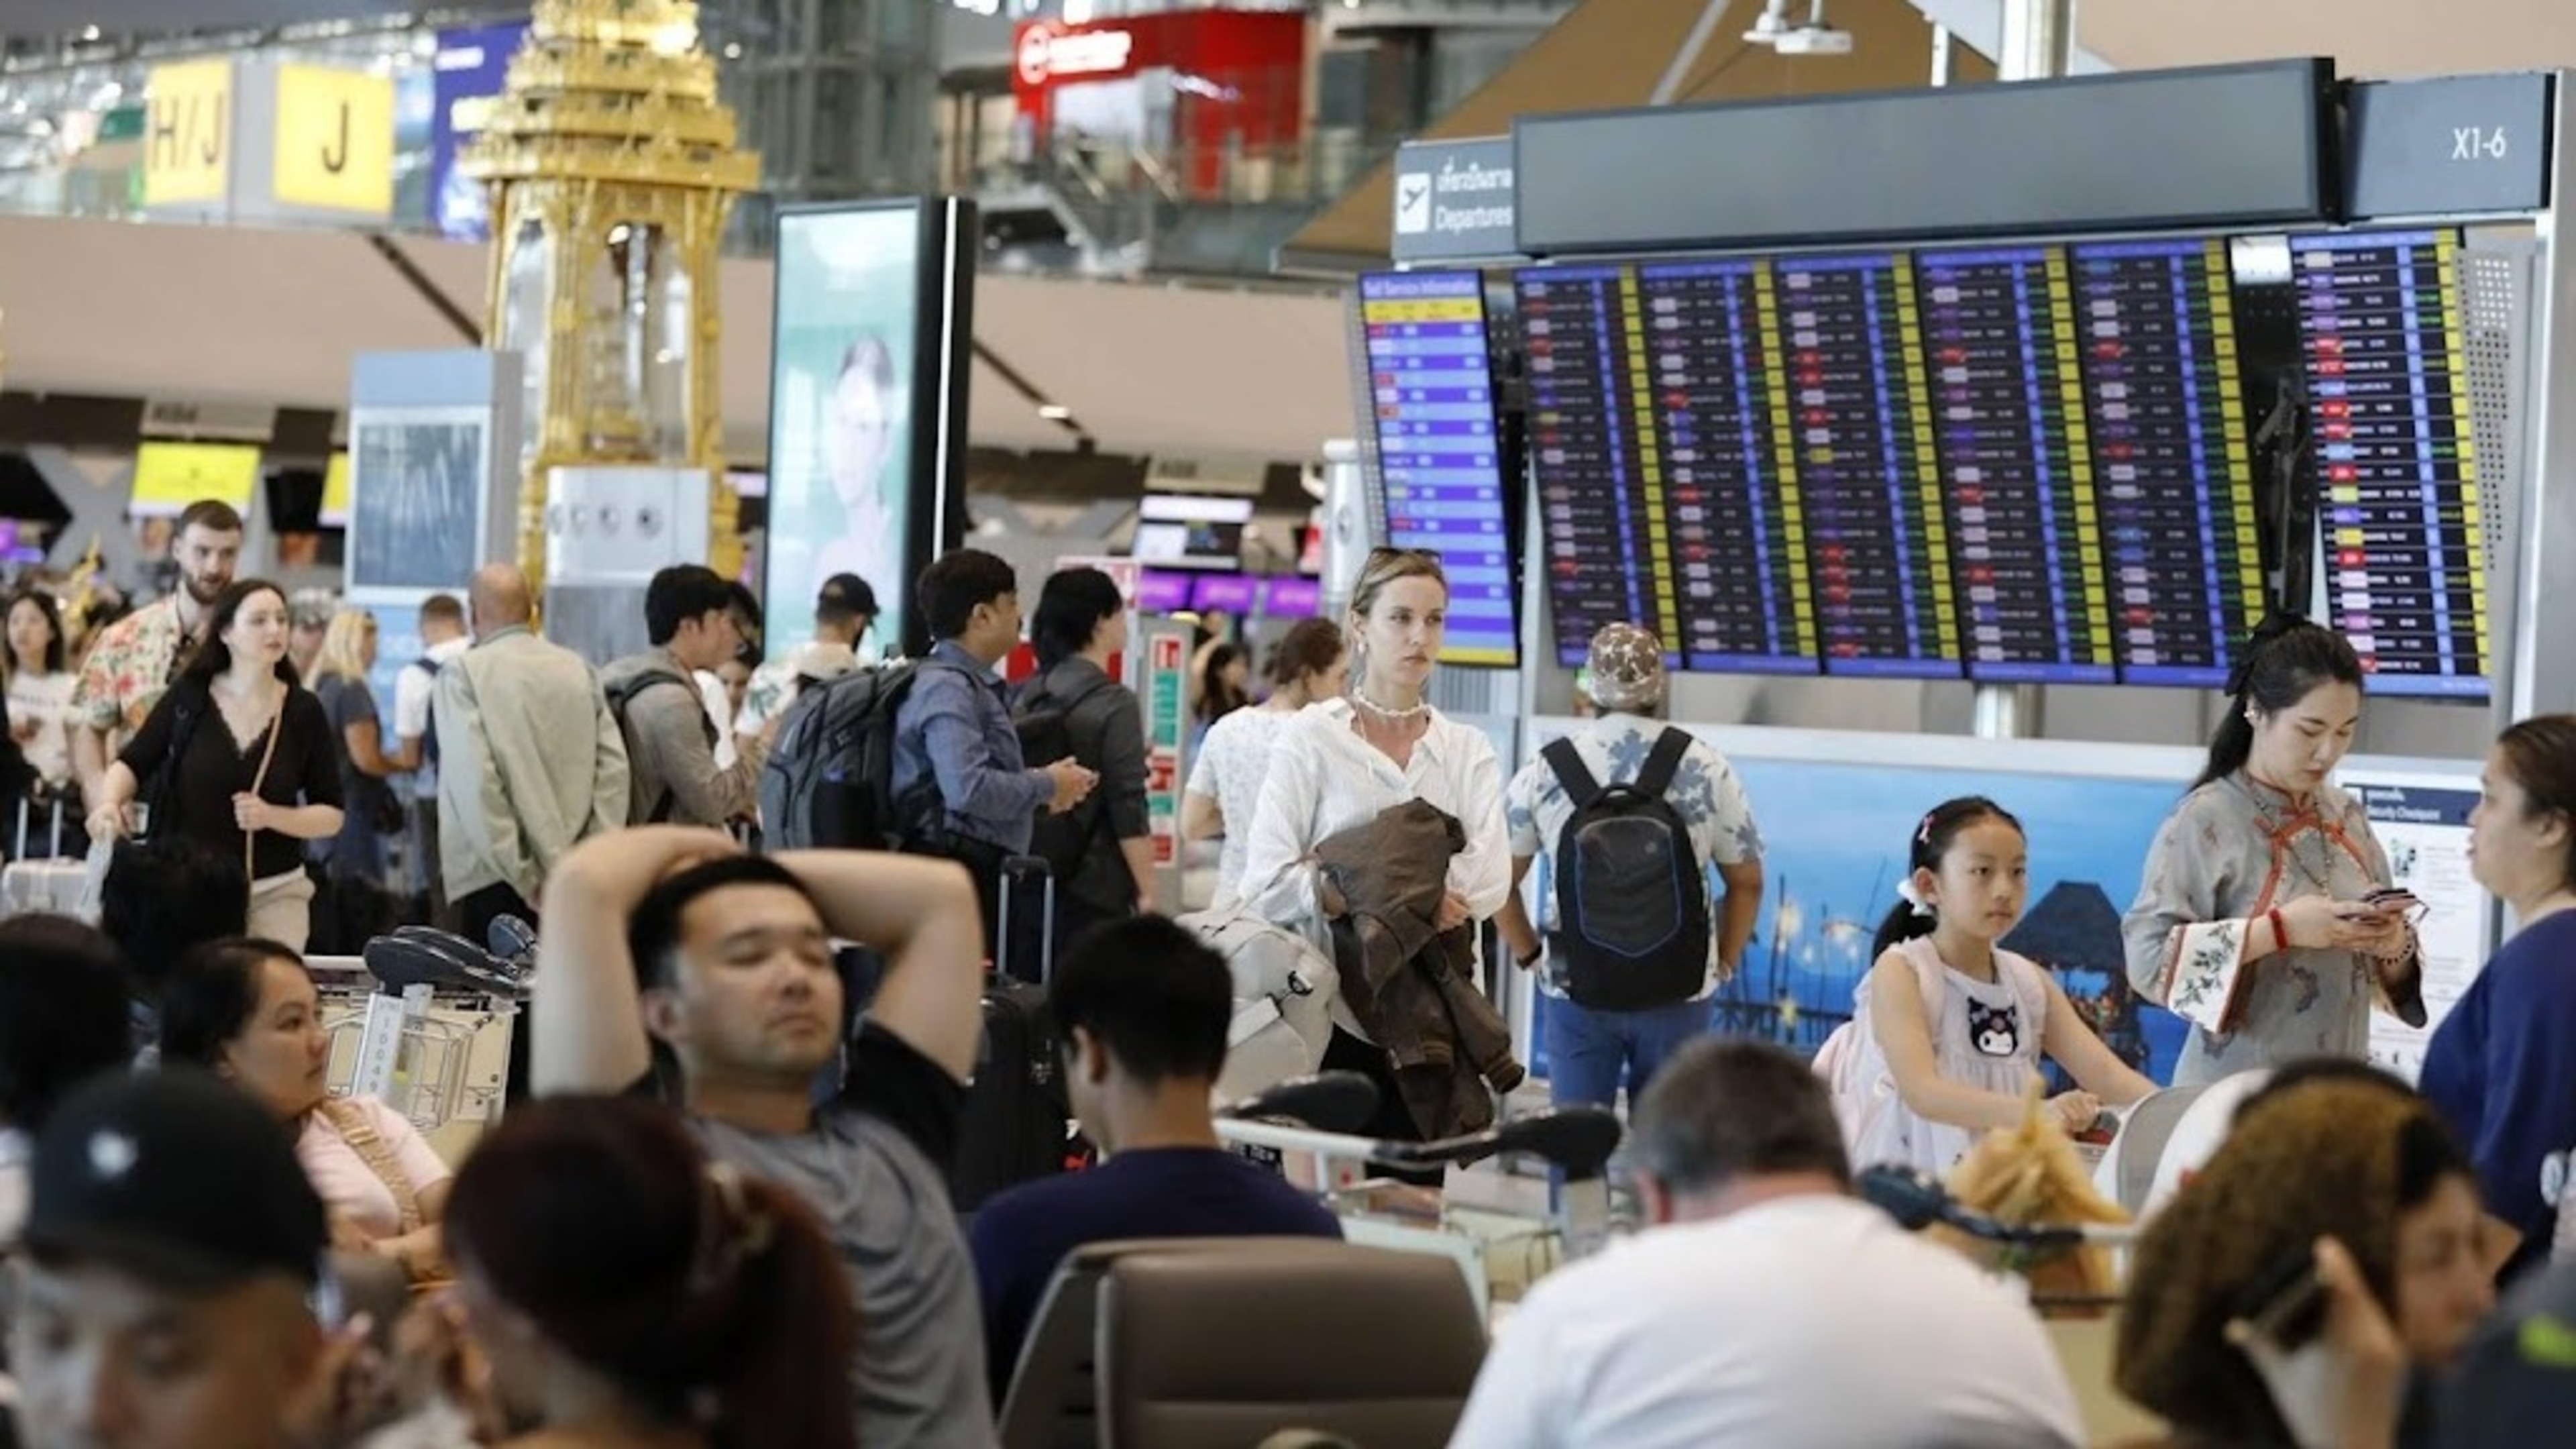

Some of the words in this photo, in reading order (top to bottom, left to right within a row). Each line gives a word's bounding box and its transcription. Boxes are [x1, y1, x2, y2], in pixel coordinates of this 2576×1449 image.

[152, 92, 225, 169] H/J
[322, 99, 350, 174] J
[2452, 127, 2506, 159] X1-6
